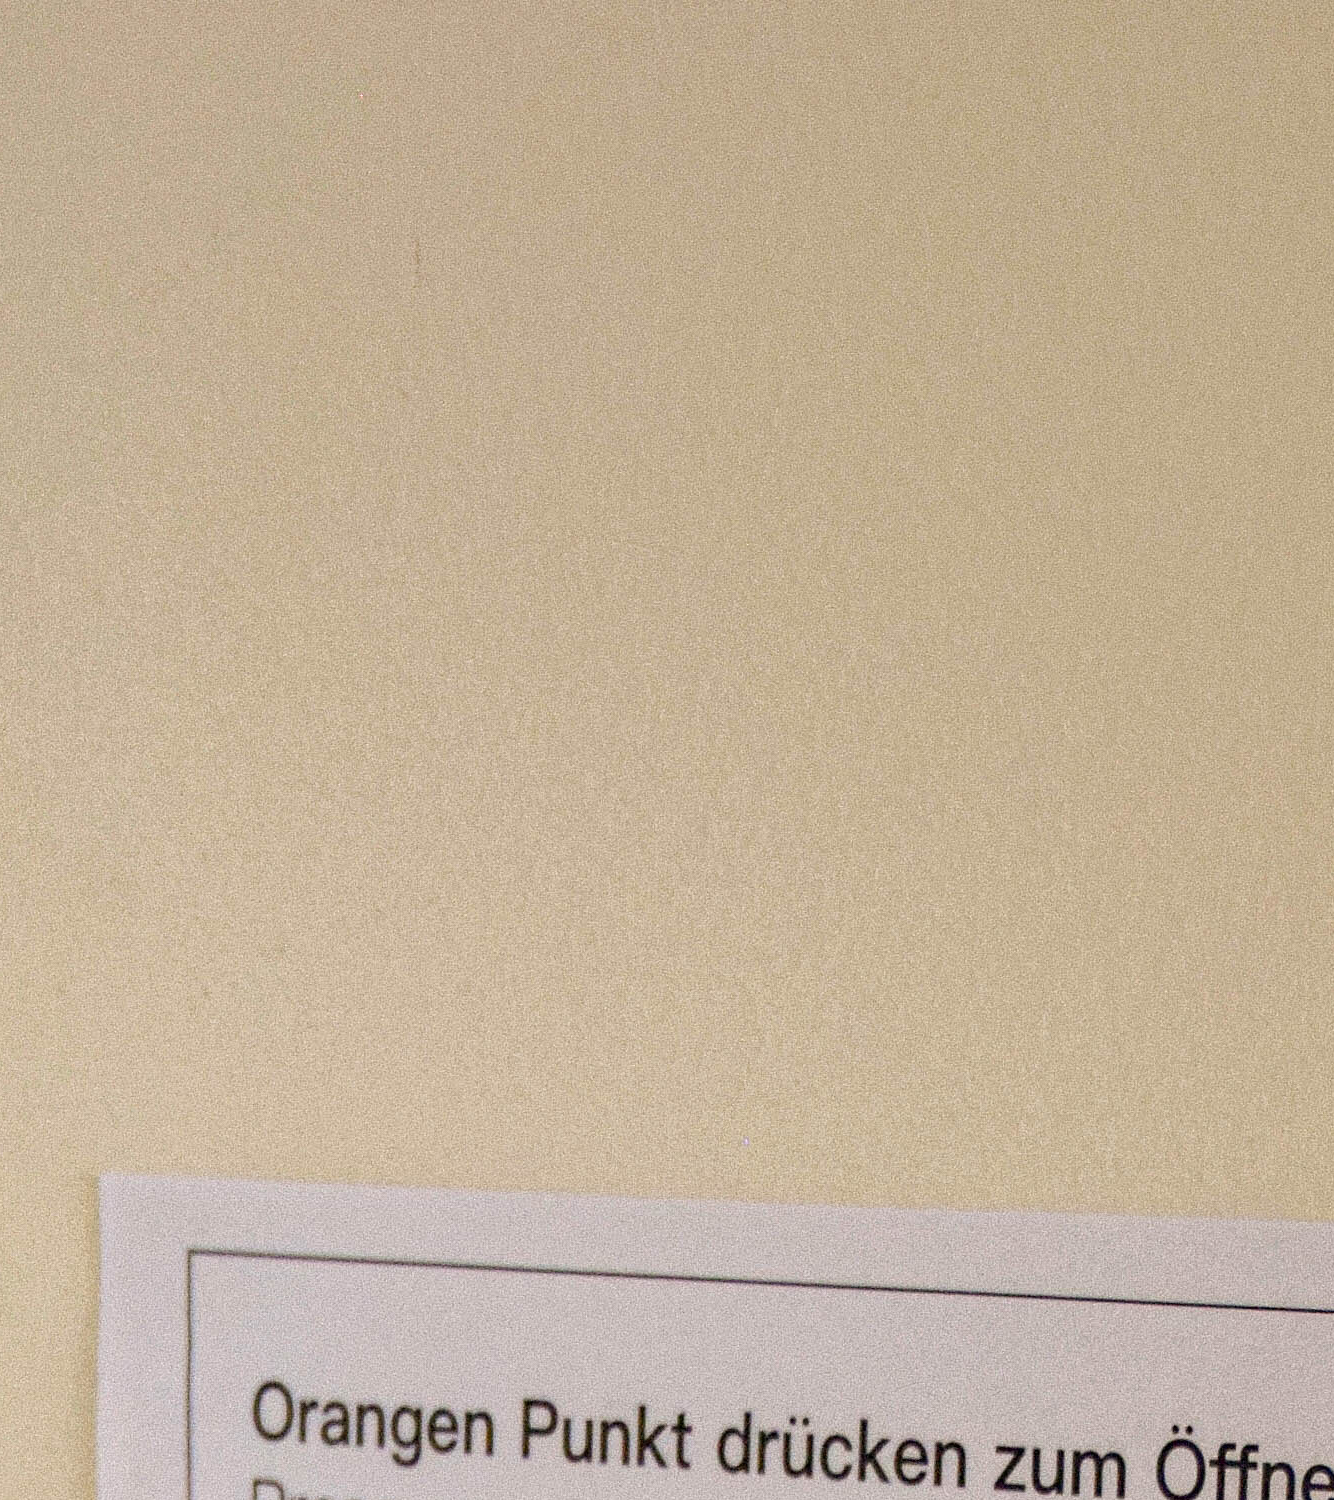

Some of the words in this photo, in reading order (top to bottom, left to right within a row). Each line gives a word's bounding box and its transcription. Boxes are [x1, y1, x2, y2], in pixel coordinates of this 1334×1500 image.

[251, 1379, 496, 1469] Orangen
[520, 1397, 694, 1471] Punkt
[716, 1410, 968, 1490] drücken
[992, 1443, 1128, 1500] zum
